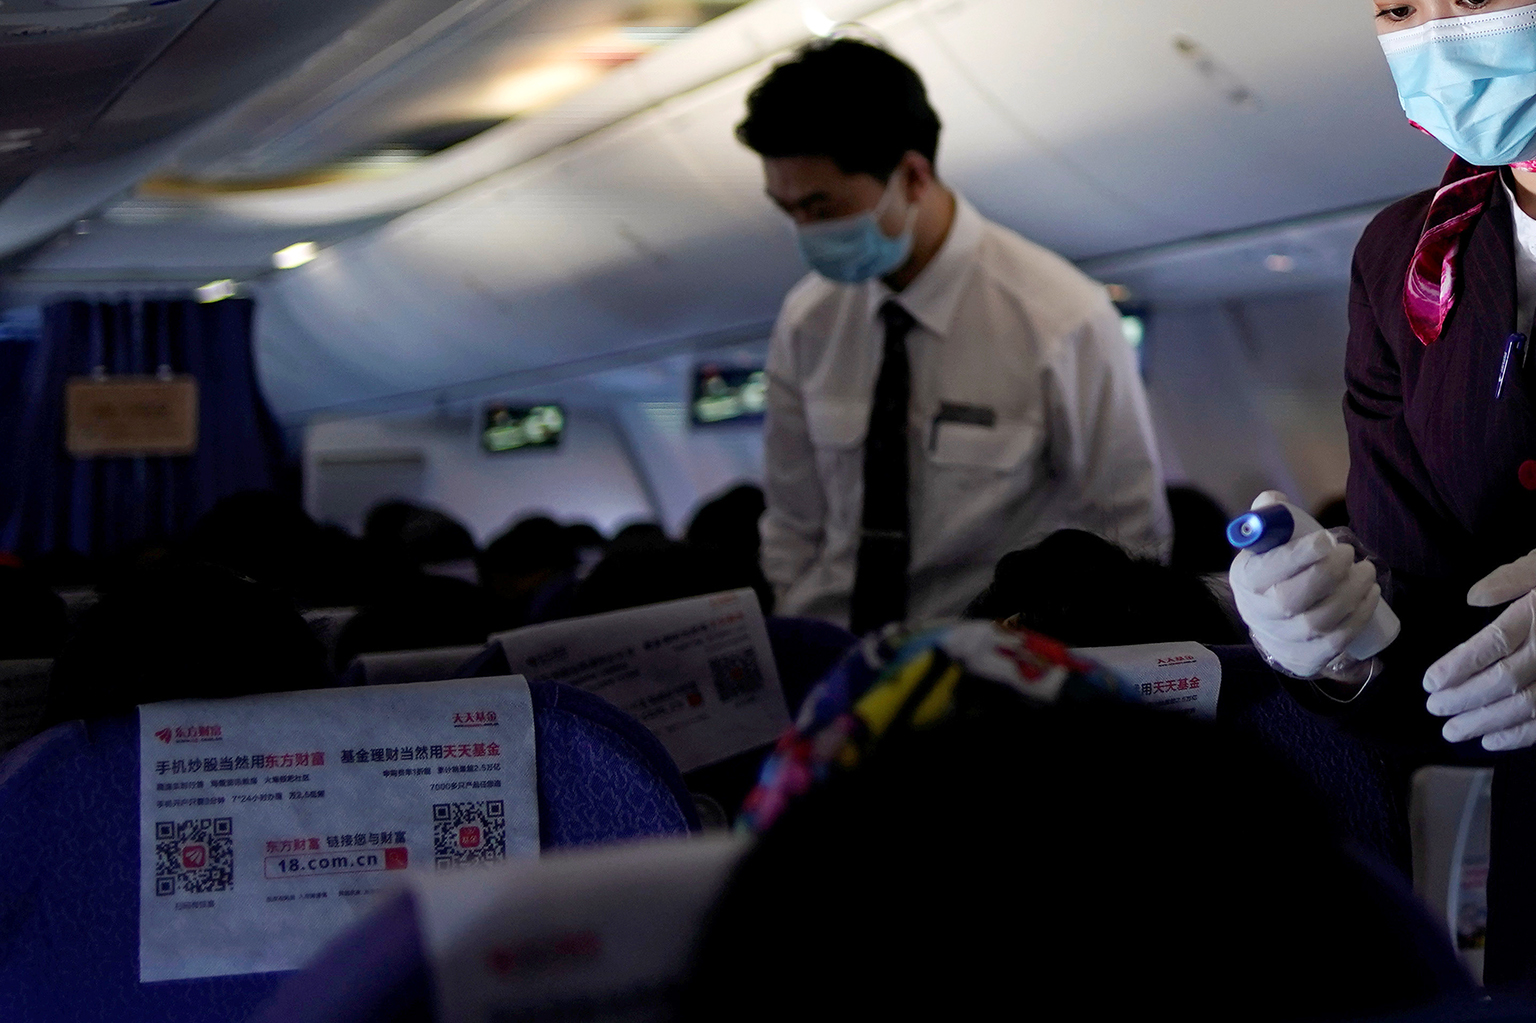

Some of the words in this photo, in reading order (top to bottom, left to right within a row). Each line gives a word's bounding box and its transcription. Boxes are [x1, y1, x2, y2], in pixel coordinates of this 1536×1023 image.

[155, 751, 326, 775] 手机炒股当然用东方财富
[340, 741, 501, 764] 基金理财当然用天天基金
[266, 837, 321, 854] 东方财富
[326, 830, 407, 848] 链接您与财富
[277, 853, 378, 873] 18.com.cn
